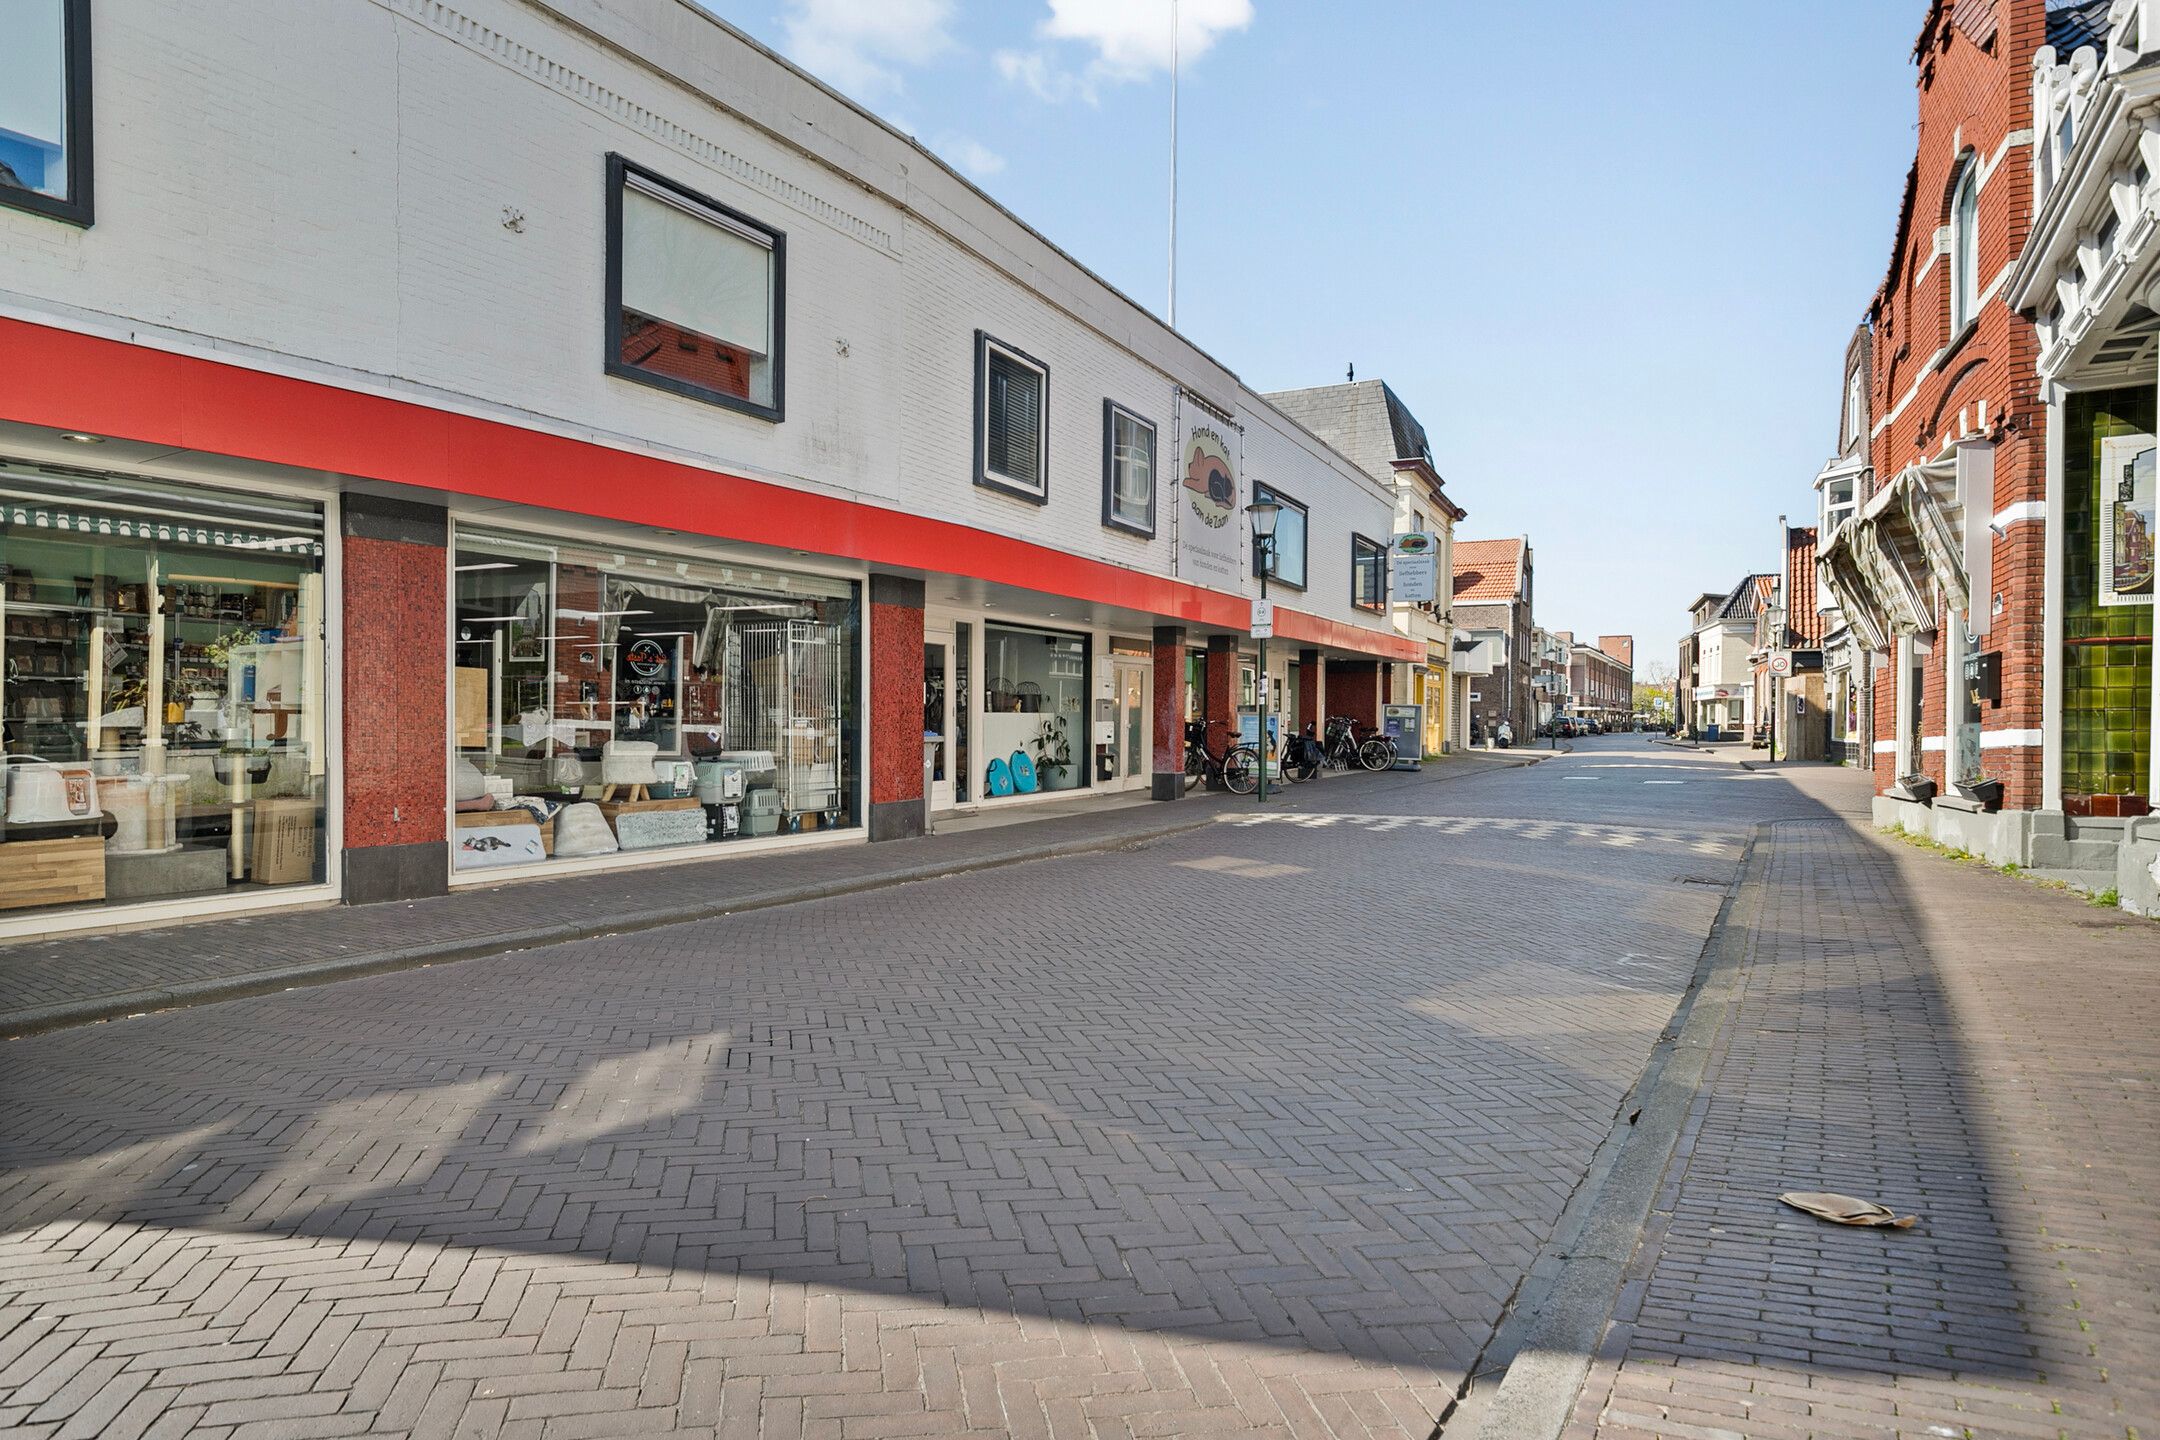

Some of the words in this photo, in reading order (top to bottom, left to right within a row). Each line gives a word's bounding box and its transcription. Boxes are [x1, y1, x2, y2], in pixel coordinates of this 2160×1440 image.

[1191, 424, 1210, 441] Hond
[1210, 431, 1220, 444] en
[1220, 434, 1230, 460] kat
[1191, 501, 1205, 522] aan
[1204, 512, 1213, 528] de
